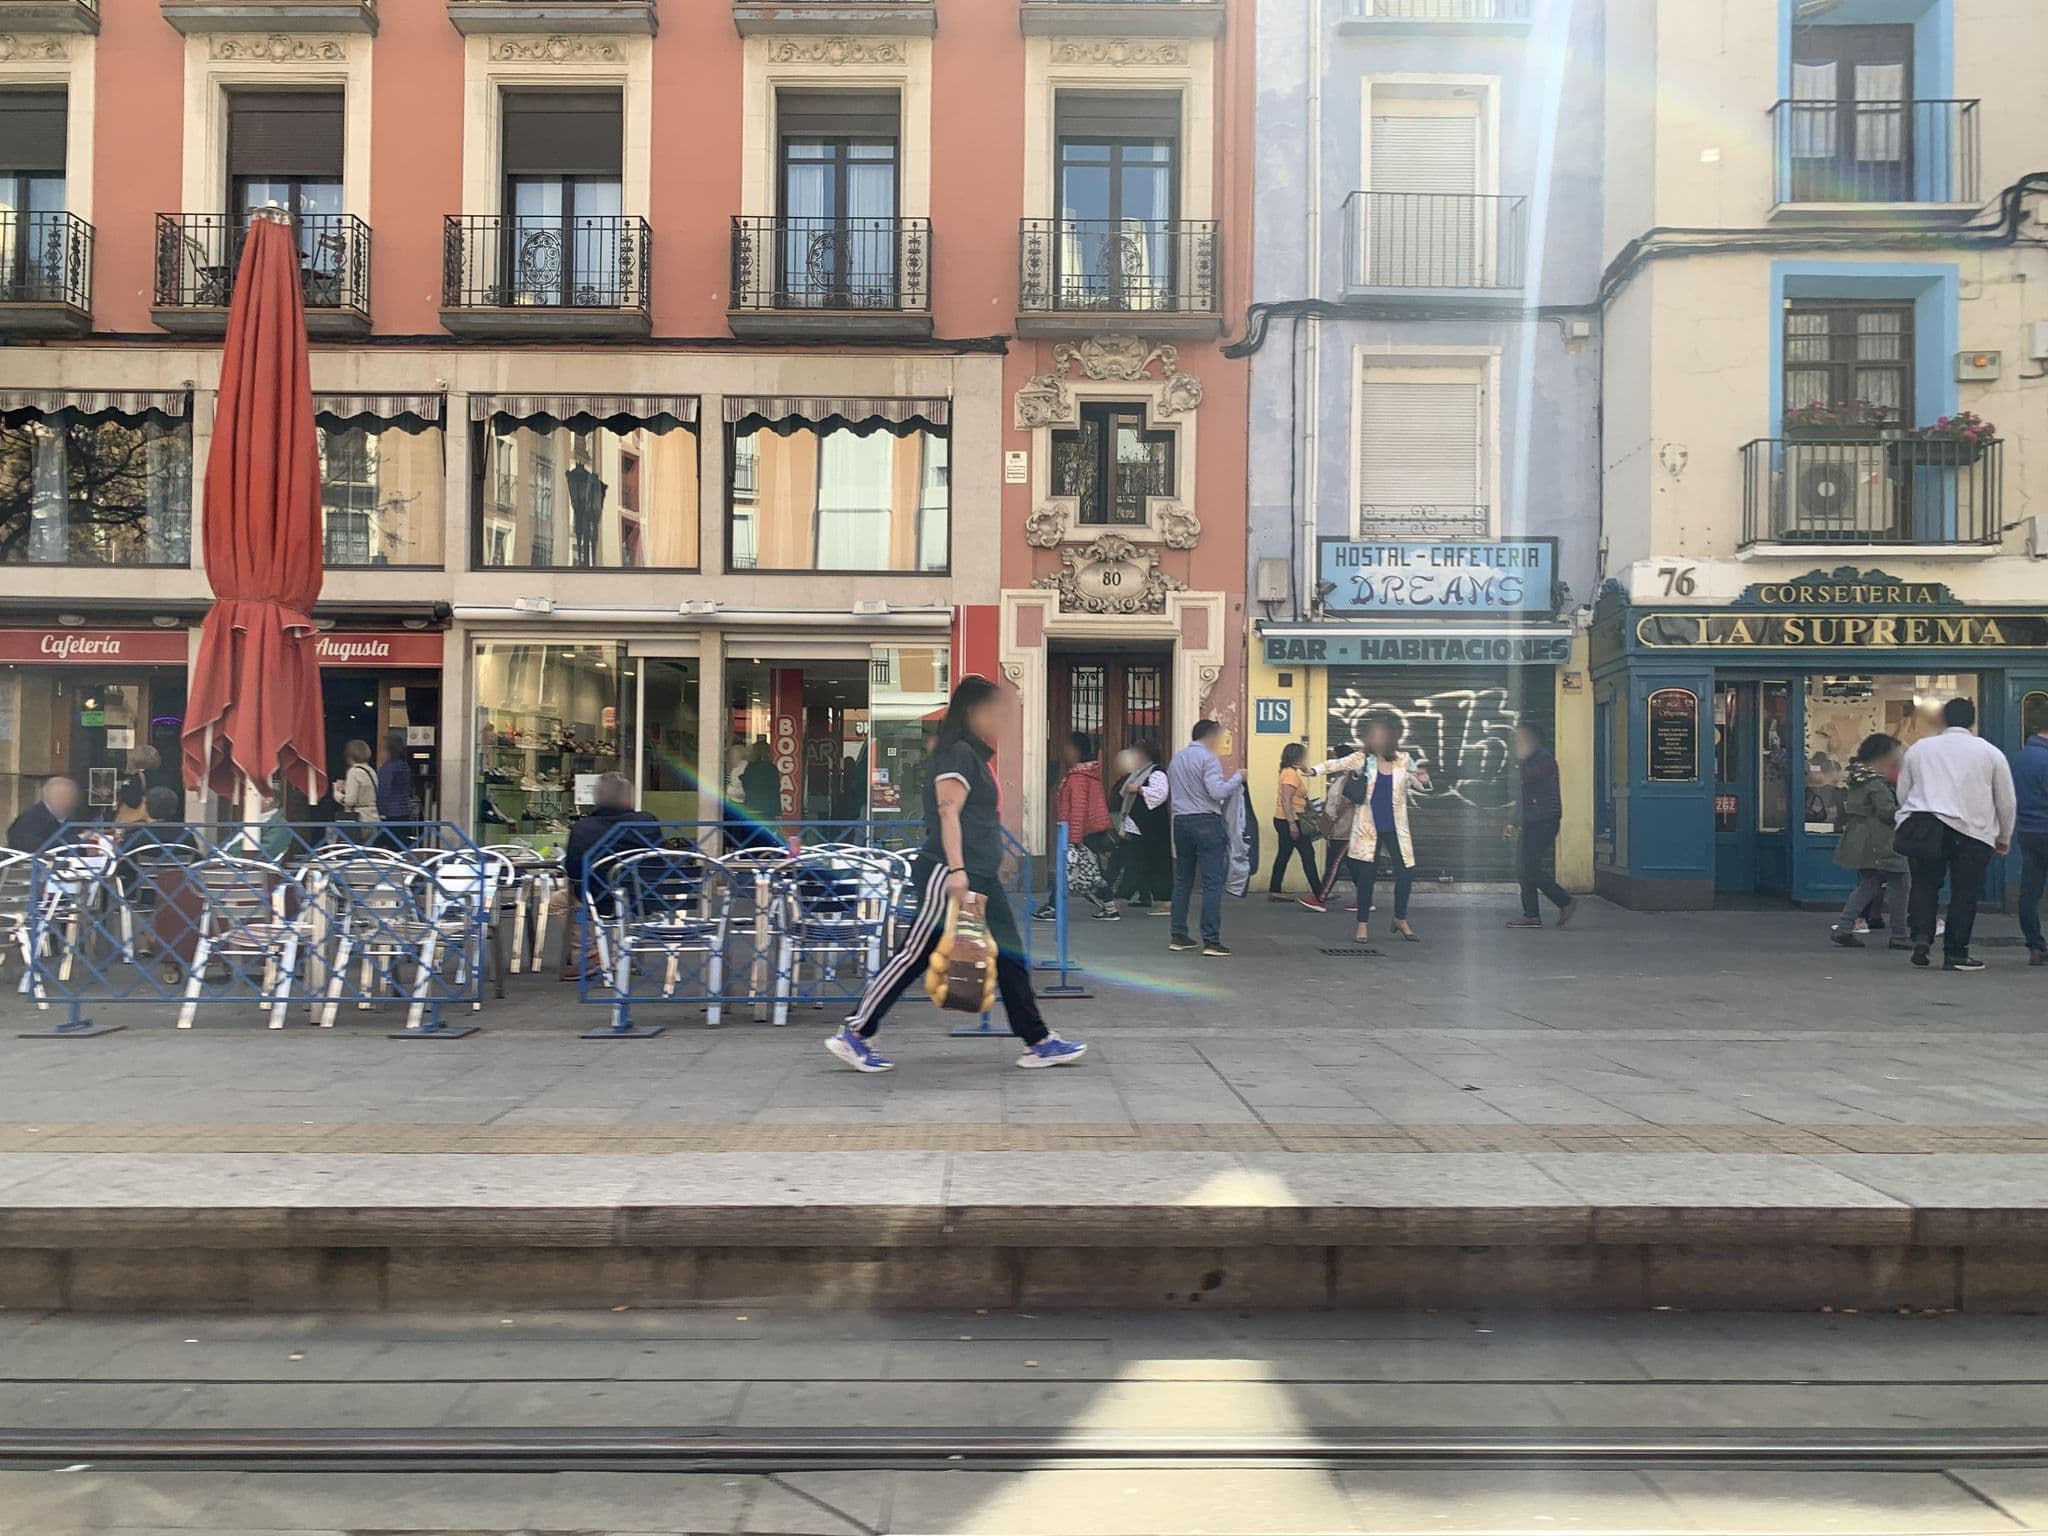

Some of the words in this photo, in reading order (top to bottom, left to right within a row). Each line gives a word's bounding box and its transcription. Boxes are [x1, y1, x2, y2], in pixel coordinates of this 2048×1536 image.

[1335, 546, 1411, 567] HOSTAL
[1103, 571, 1122, 586] 80
[1350, 574, 1524, 606] DREAMS
[1657, 567, 1697, 597] 76
[1760, 585, 1934, 604] CORSETERIA
[1696, 618, 1754, 645] LA
[1783, 617, 2006, 645] SUPREMA
[41, 634, 120, 659] Cafetería
[314, 637, 390, 662] Augusta
[1267, 639, 1327, 660] BAR
[1360, 639, 1569, 661] HABITACIONES
[1258, 701, 1288, 722] HS
[777, 717, 796, 812] BOGAR
